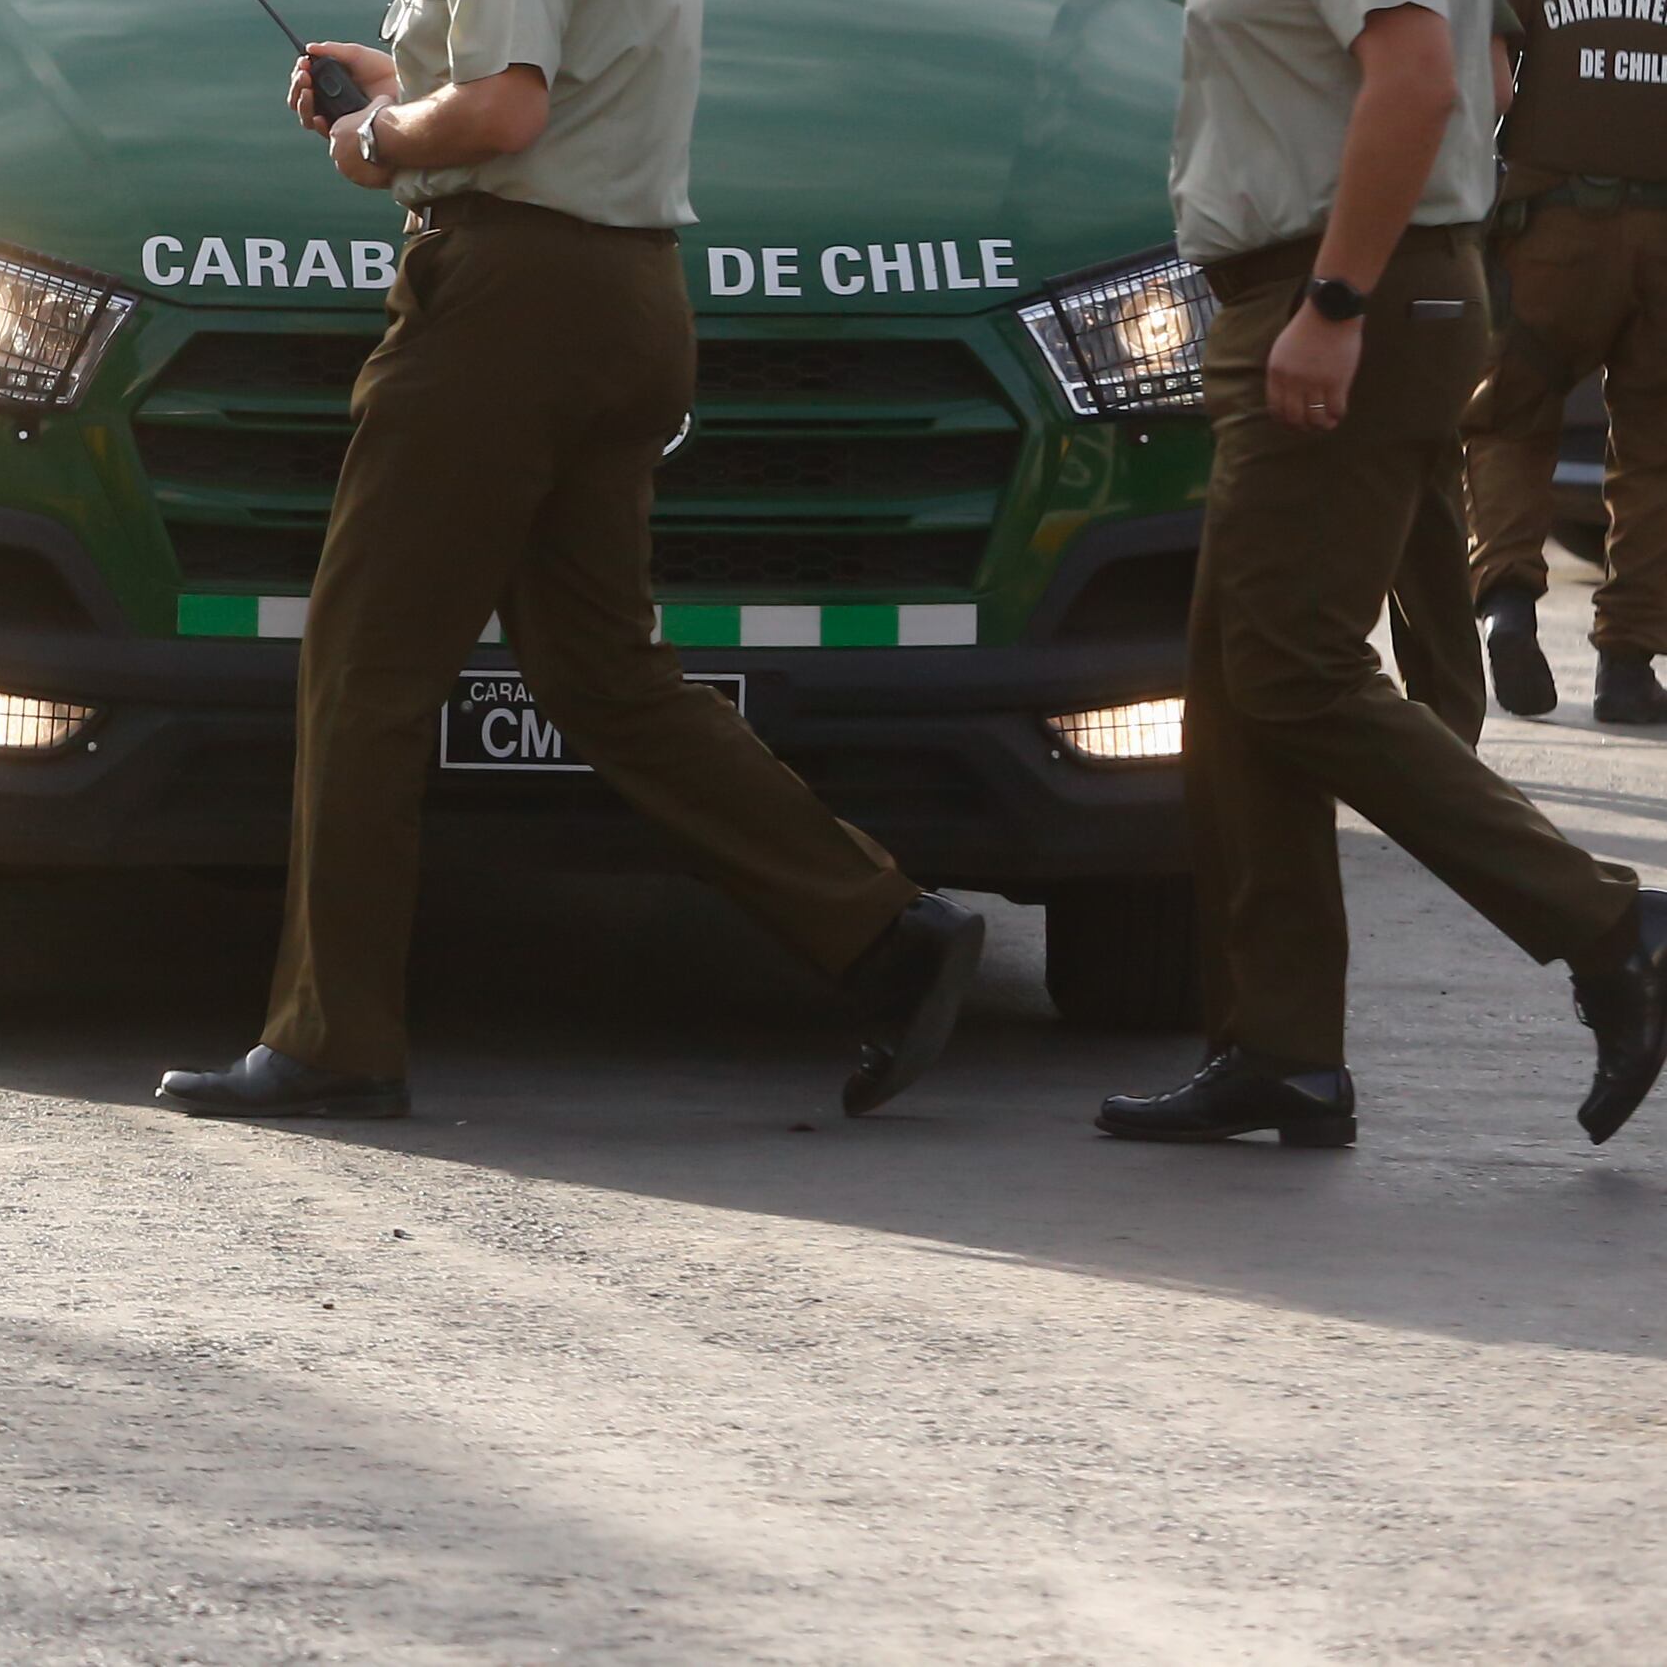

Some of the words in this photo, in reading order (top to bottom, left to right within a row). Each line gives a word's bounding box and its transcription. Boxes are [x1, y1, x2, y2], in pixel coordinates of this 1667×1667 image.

[1580, 48, 1605, 79] DE
[707, 245, 802, 297] DE
[819, 238, 1019, 296] CHILE
